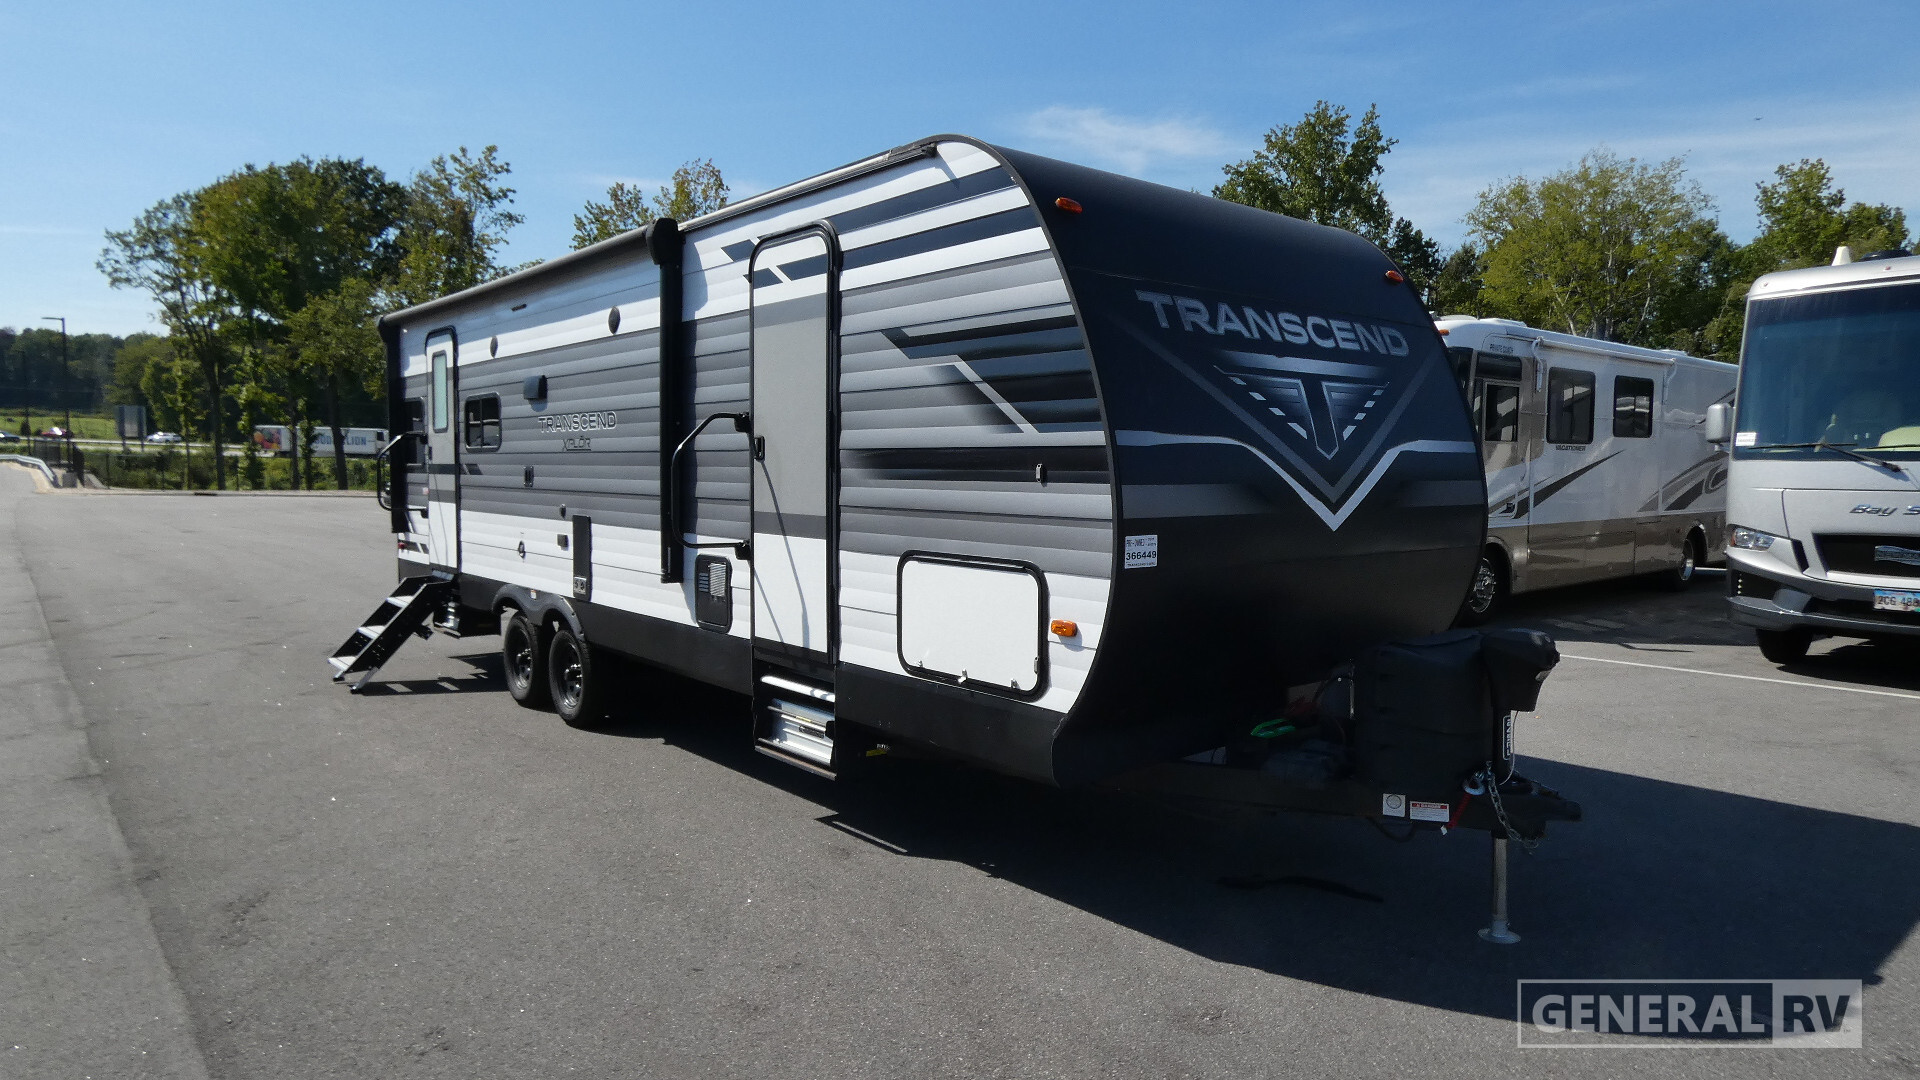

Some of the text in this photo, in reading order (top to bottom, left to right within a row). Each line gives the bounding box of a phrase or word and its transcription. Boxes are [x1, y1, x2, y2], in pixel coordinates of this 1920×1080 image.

[1135, 290, 1410, 357] TRANSCEND
[538, 411, 617, 433] TRANSCEND
[1849, 504, 1898, 517] Bay
[1126, 550, 1157, 561] 366449
